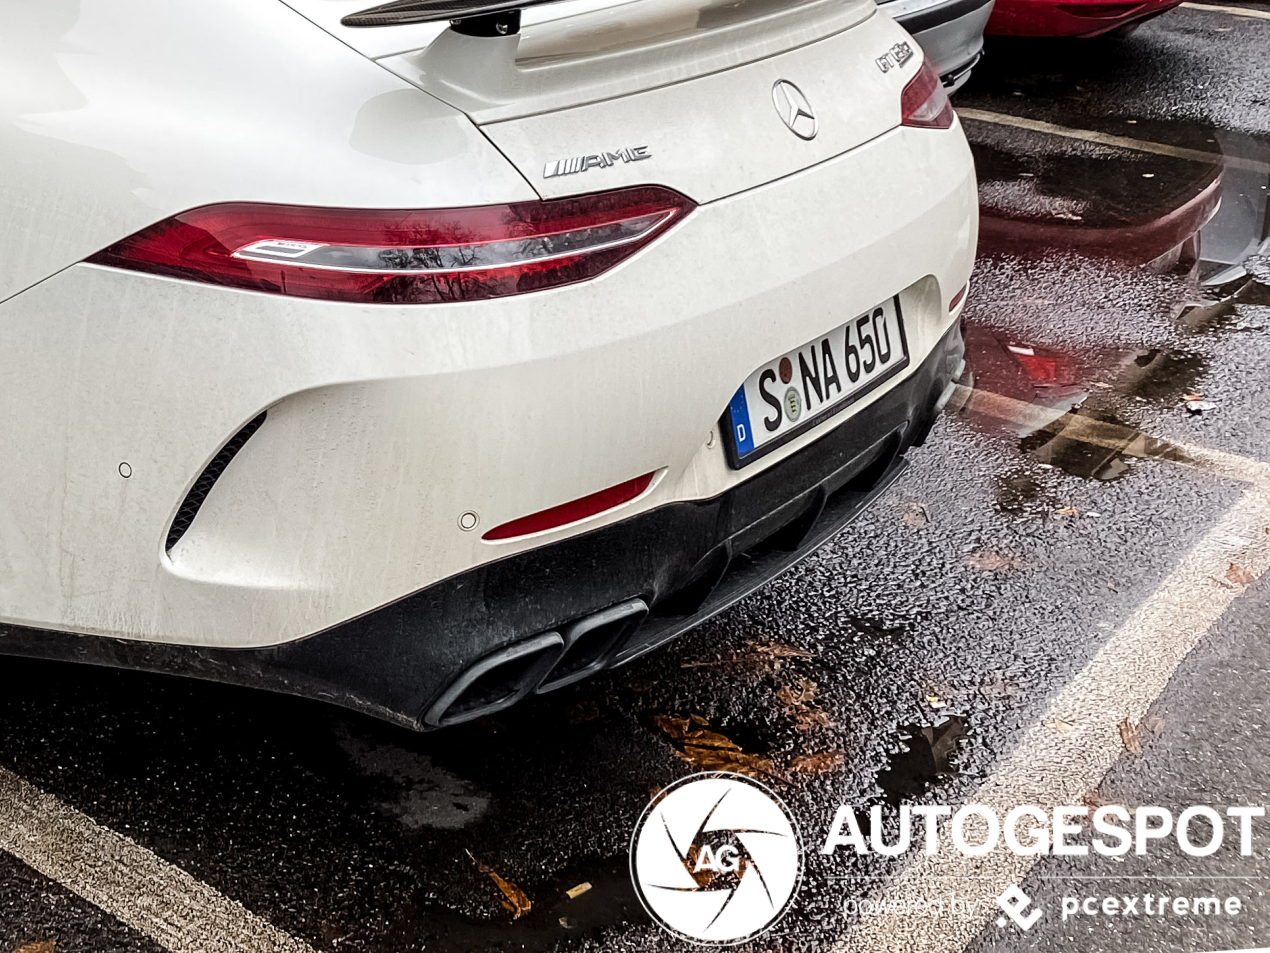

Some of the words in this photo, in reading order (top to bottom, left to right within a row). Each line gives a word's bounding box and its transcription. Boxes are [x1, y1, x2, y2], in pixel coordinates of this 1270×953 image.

[758, 368, 782, 432] S
[798, 338, 842, 411] NA
[844, 306, 892, 384] 650
[737, 423, 746, 442] D
